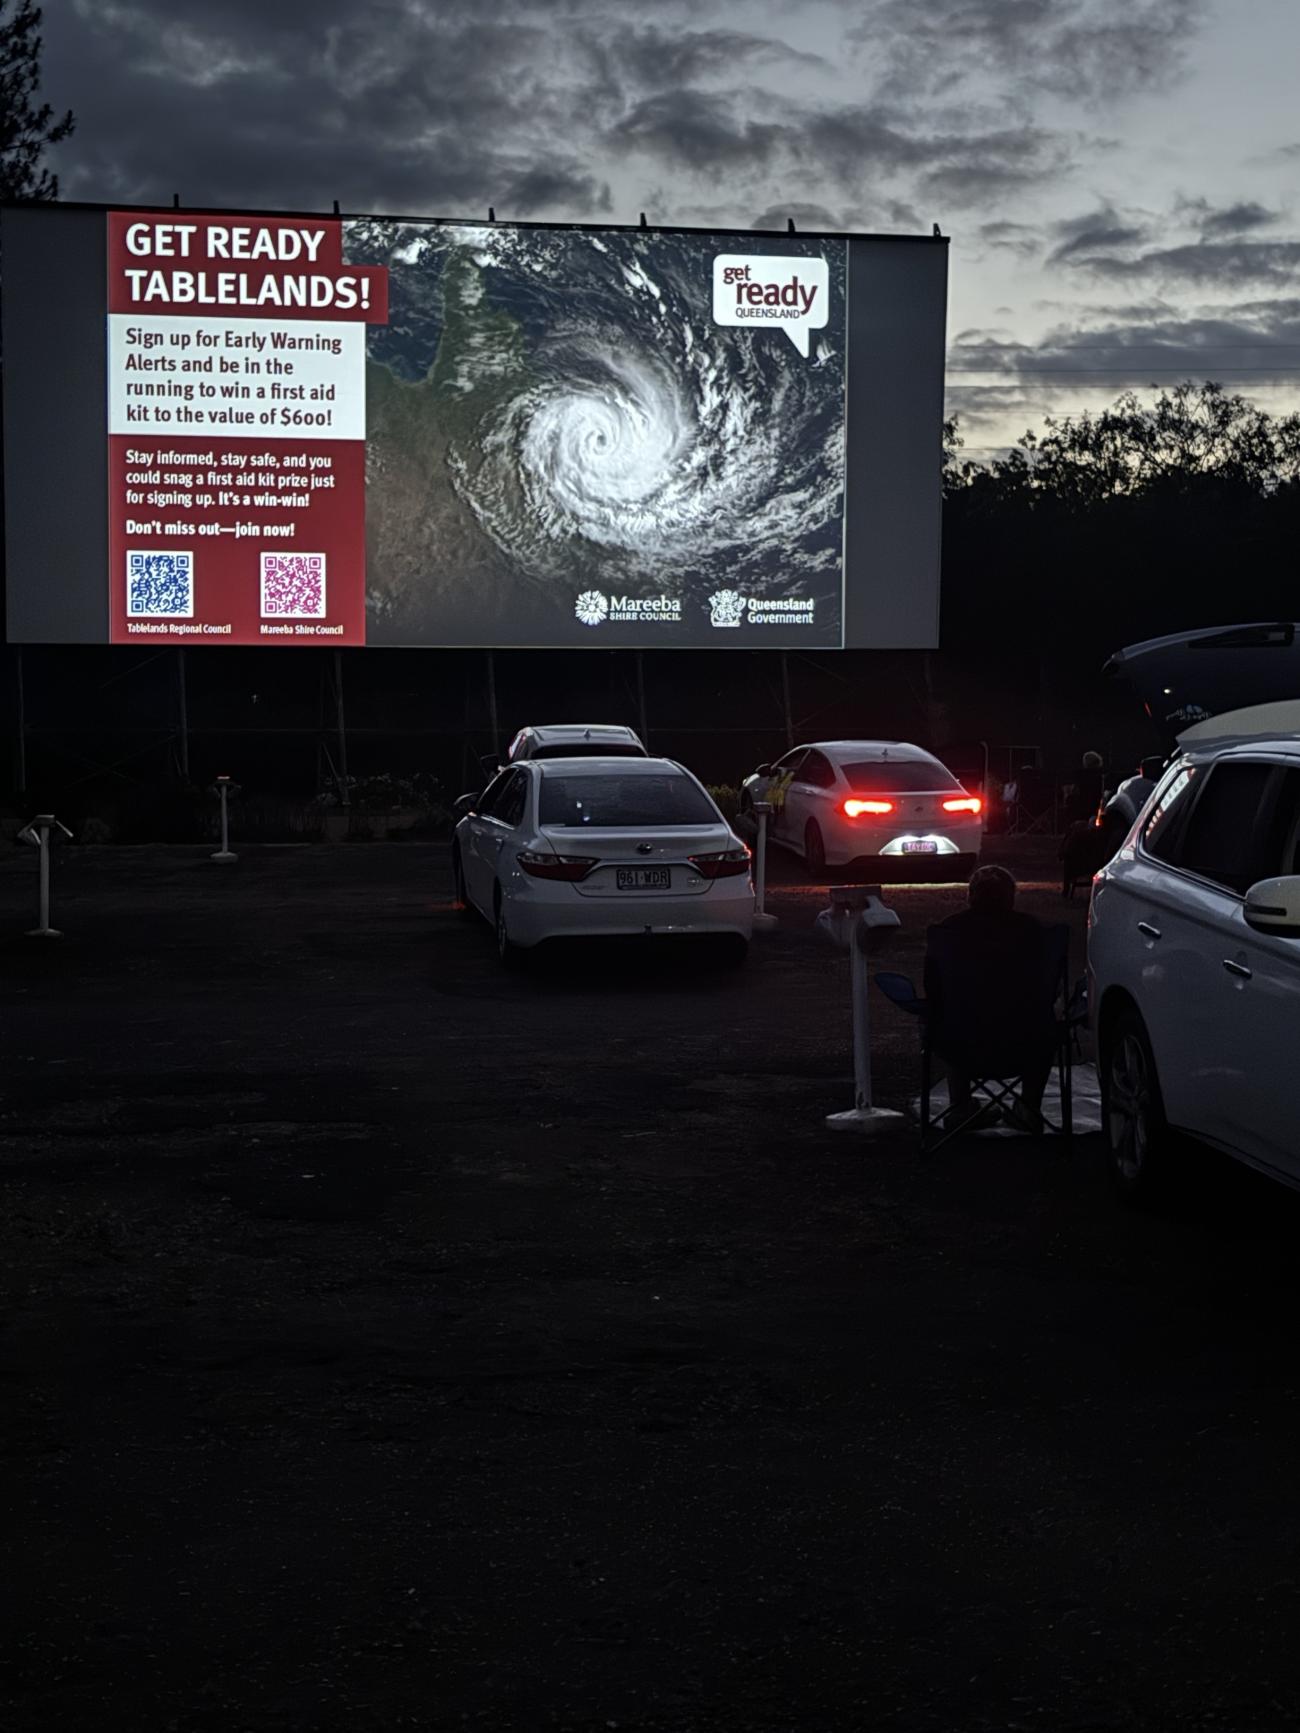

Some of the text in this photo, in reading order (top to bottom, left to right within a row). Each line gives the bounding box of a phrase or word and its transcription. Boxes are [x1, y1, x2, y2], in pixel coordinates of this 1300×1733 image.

[125, 222, 326, 262] GET READY
[723, 264, 751, 284] get
[124, 269, 370, 310] TABLELANDS!
[736, 275, 818, 315] ready
[736, 308, 800, 319] QUEENSLAND
[125, 328, 342, 355] Sign up for Early Warning
[125, 354, 294, 375] Alerts and be in the
[126, 380, 335, 401] running to win a first aid
[126, 404, 332, 427] kit to the value of $600!
[126, 450, 331, 470] Stay informed, stay safe, and you
[126, 471, 335, 490] could snag a first aid kit prize just
[126, 490, 310, 508] for signing up. It's a win-win!
[126, 520, 162, 535] Don't
[165, 521, 195, 535] miss
[264, 523, 295, 537] now!
[610, 595, 681, 612] Mareeba
[748, 598, 814, 612] Queensland
[610, 612, 681, 621] SHIRE COUNCIL
[748, 612, 814, 624] Government
[127, 623, 231, 635] Tablelands Regional Council
[260, 624, 343, 634] Mareeba Shire Council
